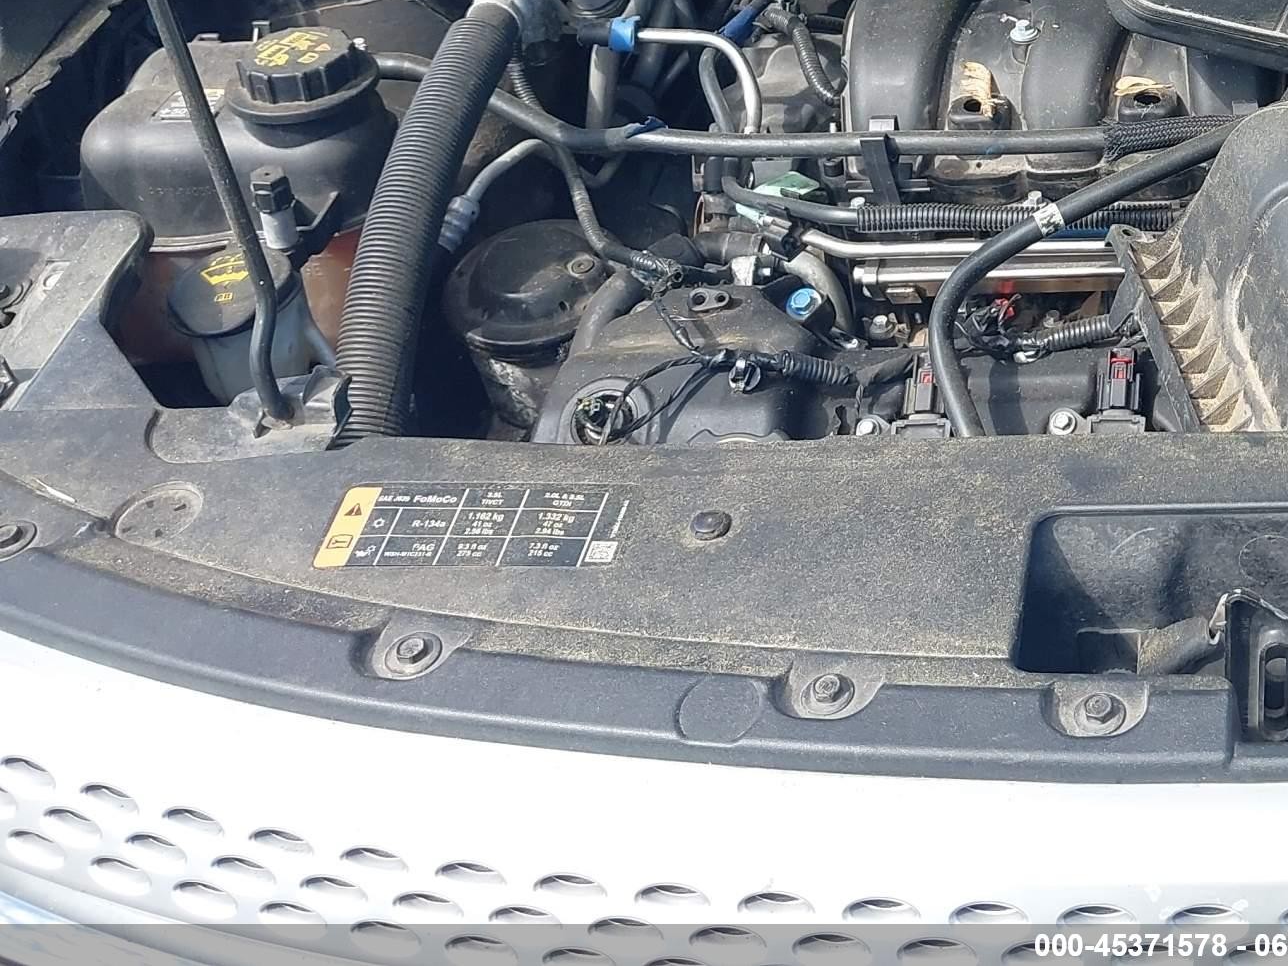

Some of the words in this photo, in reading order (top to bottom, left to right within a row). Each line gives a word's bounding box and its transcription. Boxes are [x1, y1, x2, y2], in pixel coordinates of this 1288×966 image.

[413, 495, 458, 504] FoMoCo
[492, 512, 505, 522] kg
[538, 512, 562, 521] 1.332
[562, 513, 575, 523] kg
[411, 519, 446, 528] R-134a
[411, 543, 436, 551] PAG
